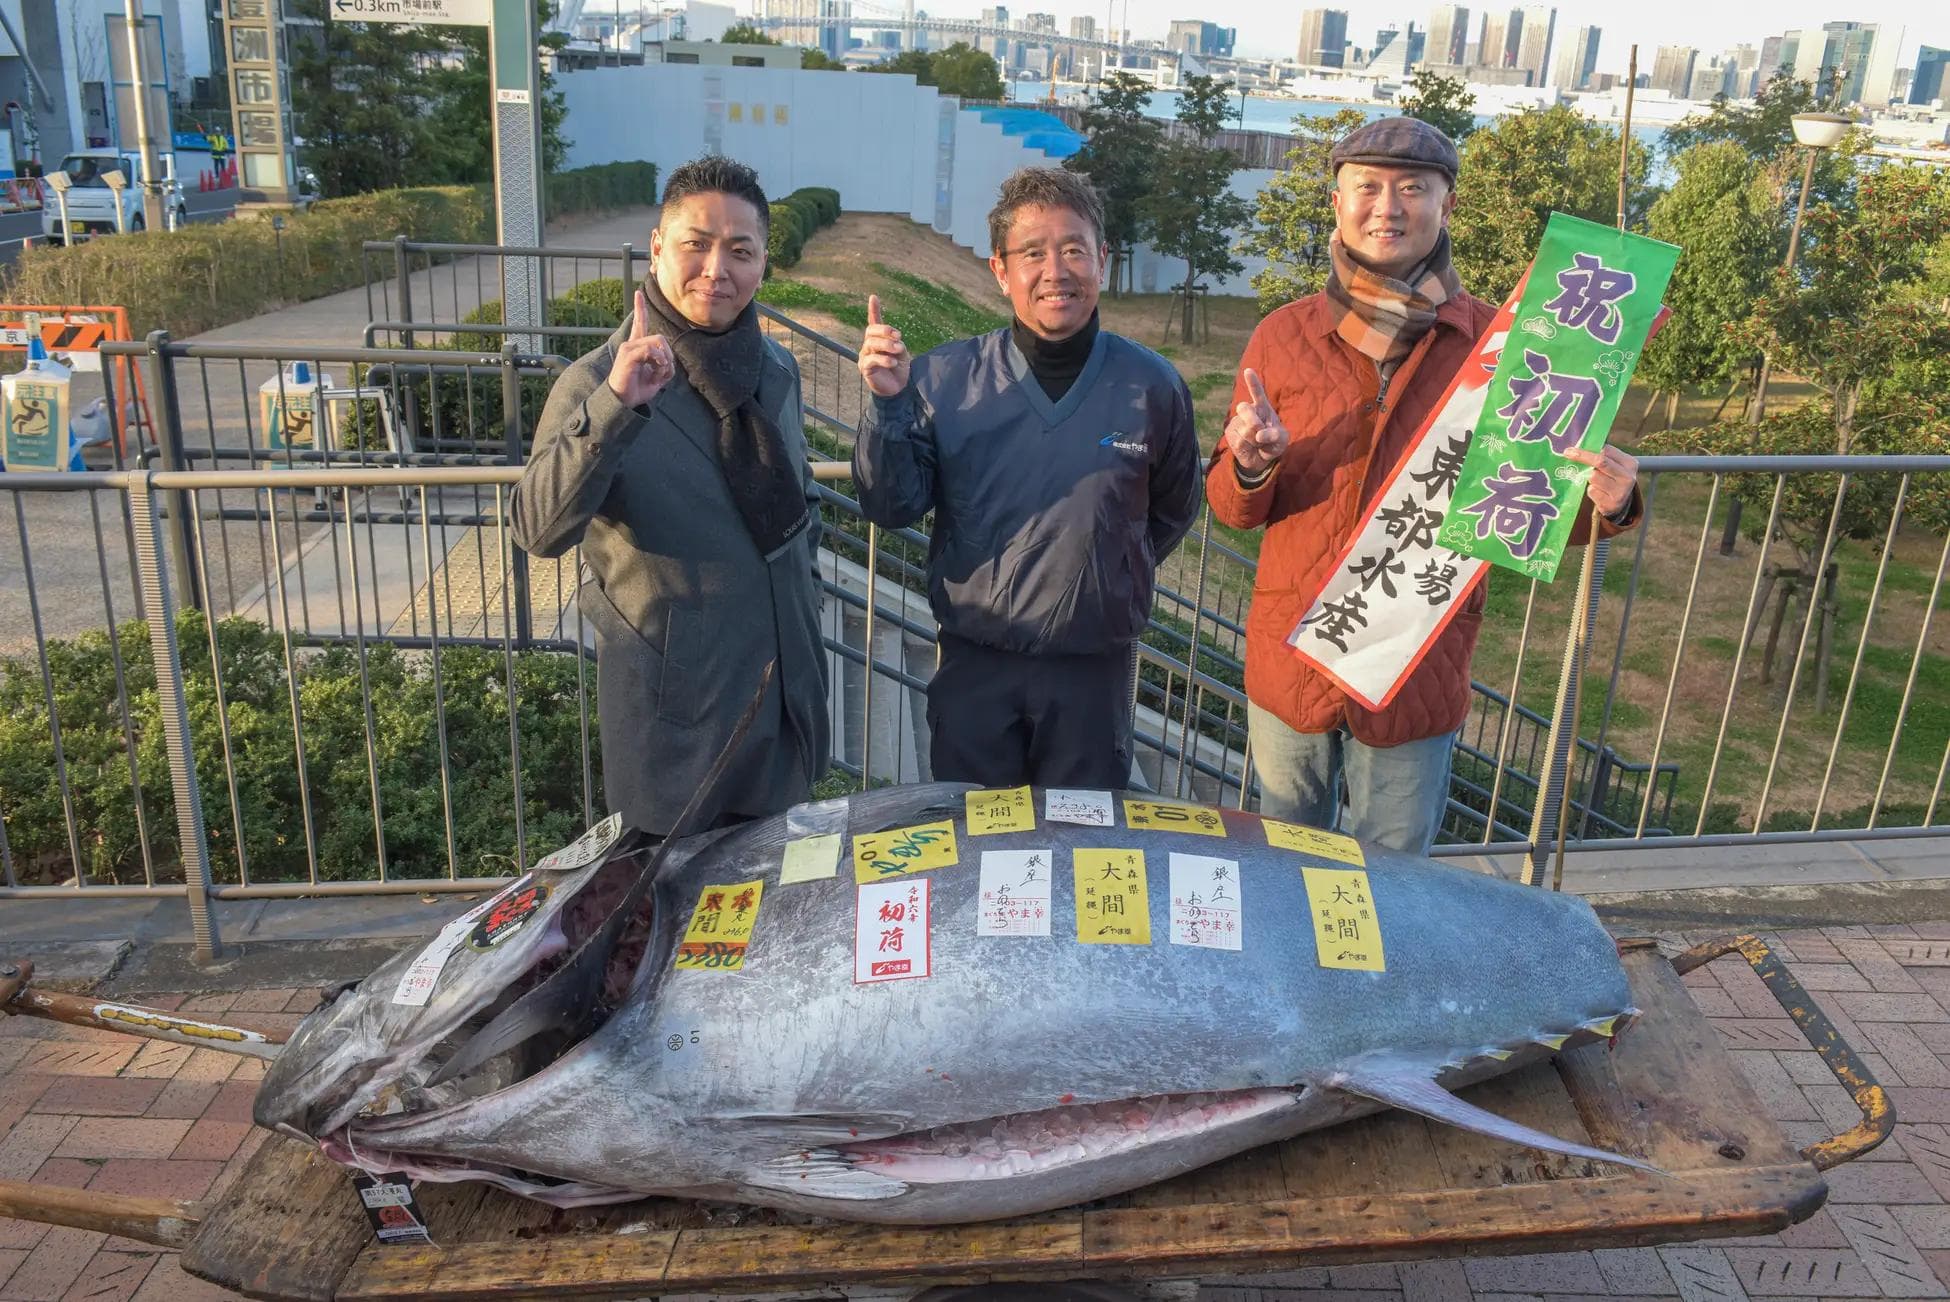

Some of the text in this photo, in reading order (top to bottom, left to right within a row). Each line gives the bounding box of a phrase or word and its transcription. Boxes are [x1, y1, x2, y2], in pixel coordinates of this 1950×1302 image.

[354, 0, 400, 13] 0.3km
[1457, 252, 1637, 561] 祝初荷
[1101, 861, 1124, 916] 大間
[1125, 854, 1140, 895] 青森県
[907, 885, 920, 924] 令和六年
[1332, 884, 1359, 940] 大間
[1351, 878, 1370, 920] 青森県
[878, 899, 906, 953] 初荷
